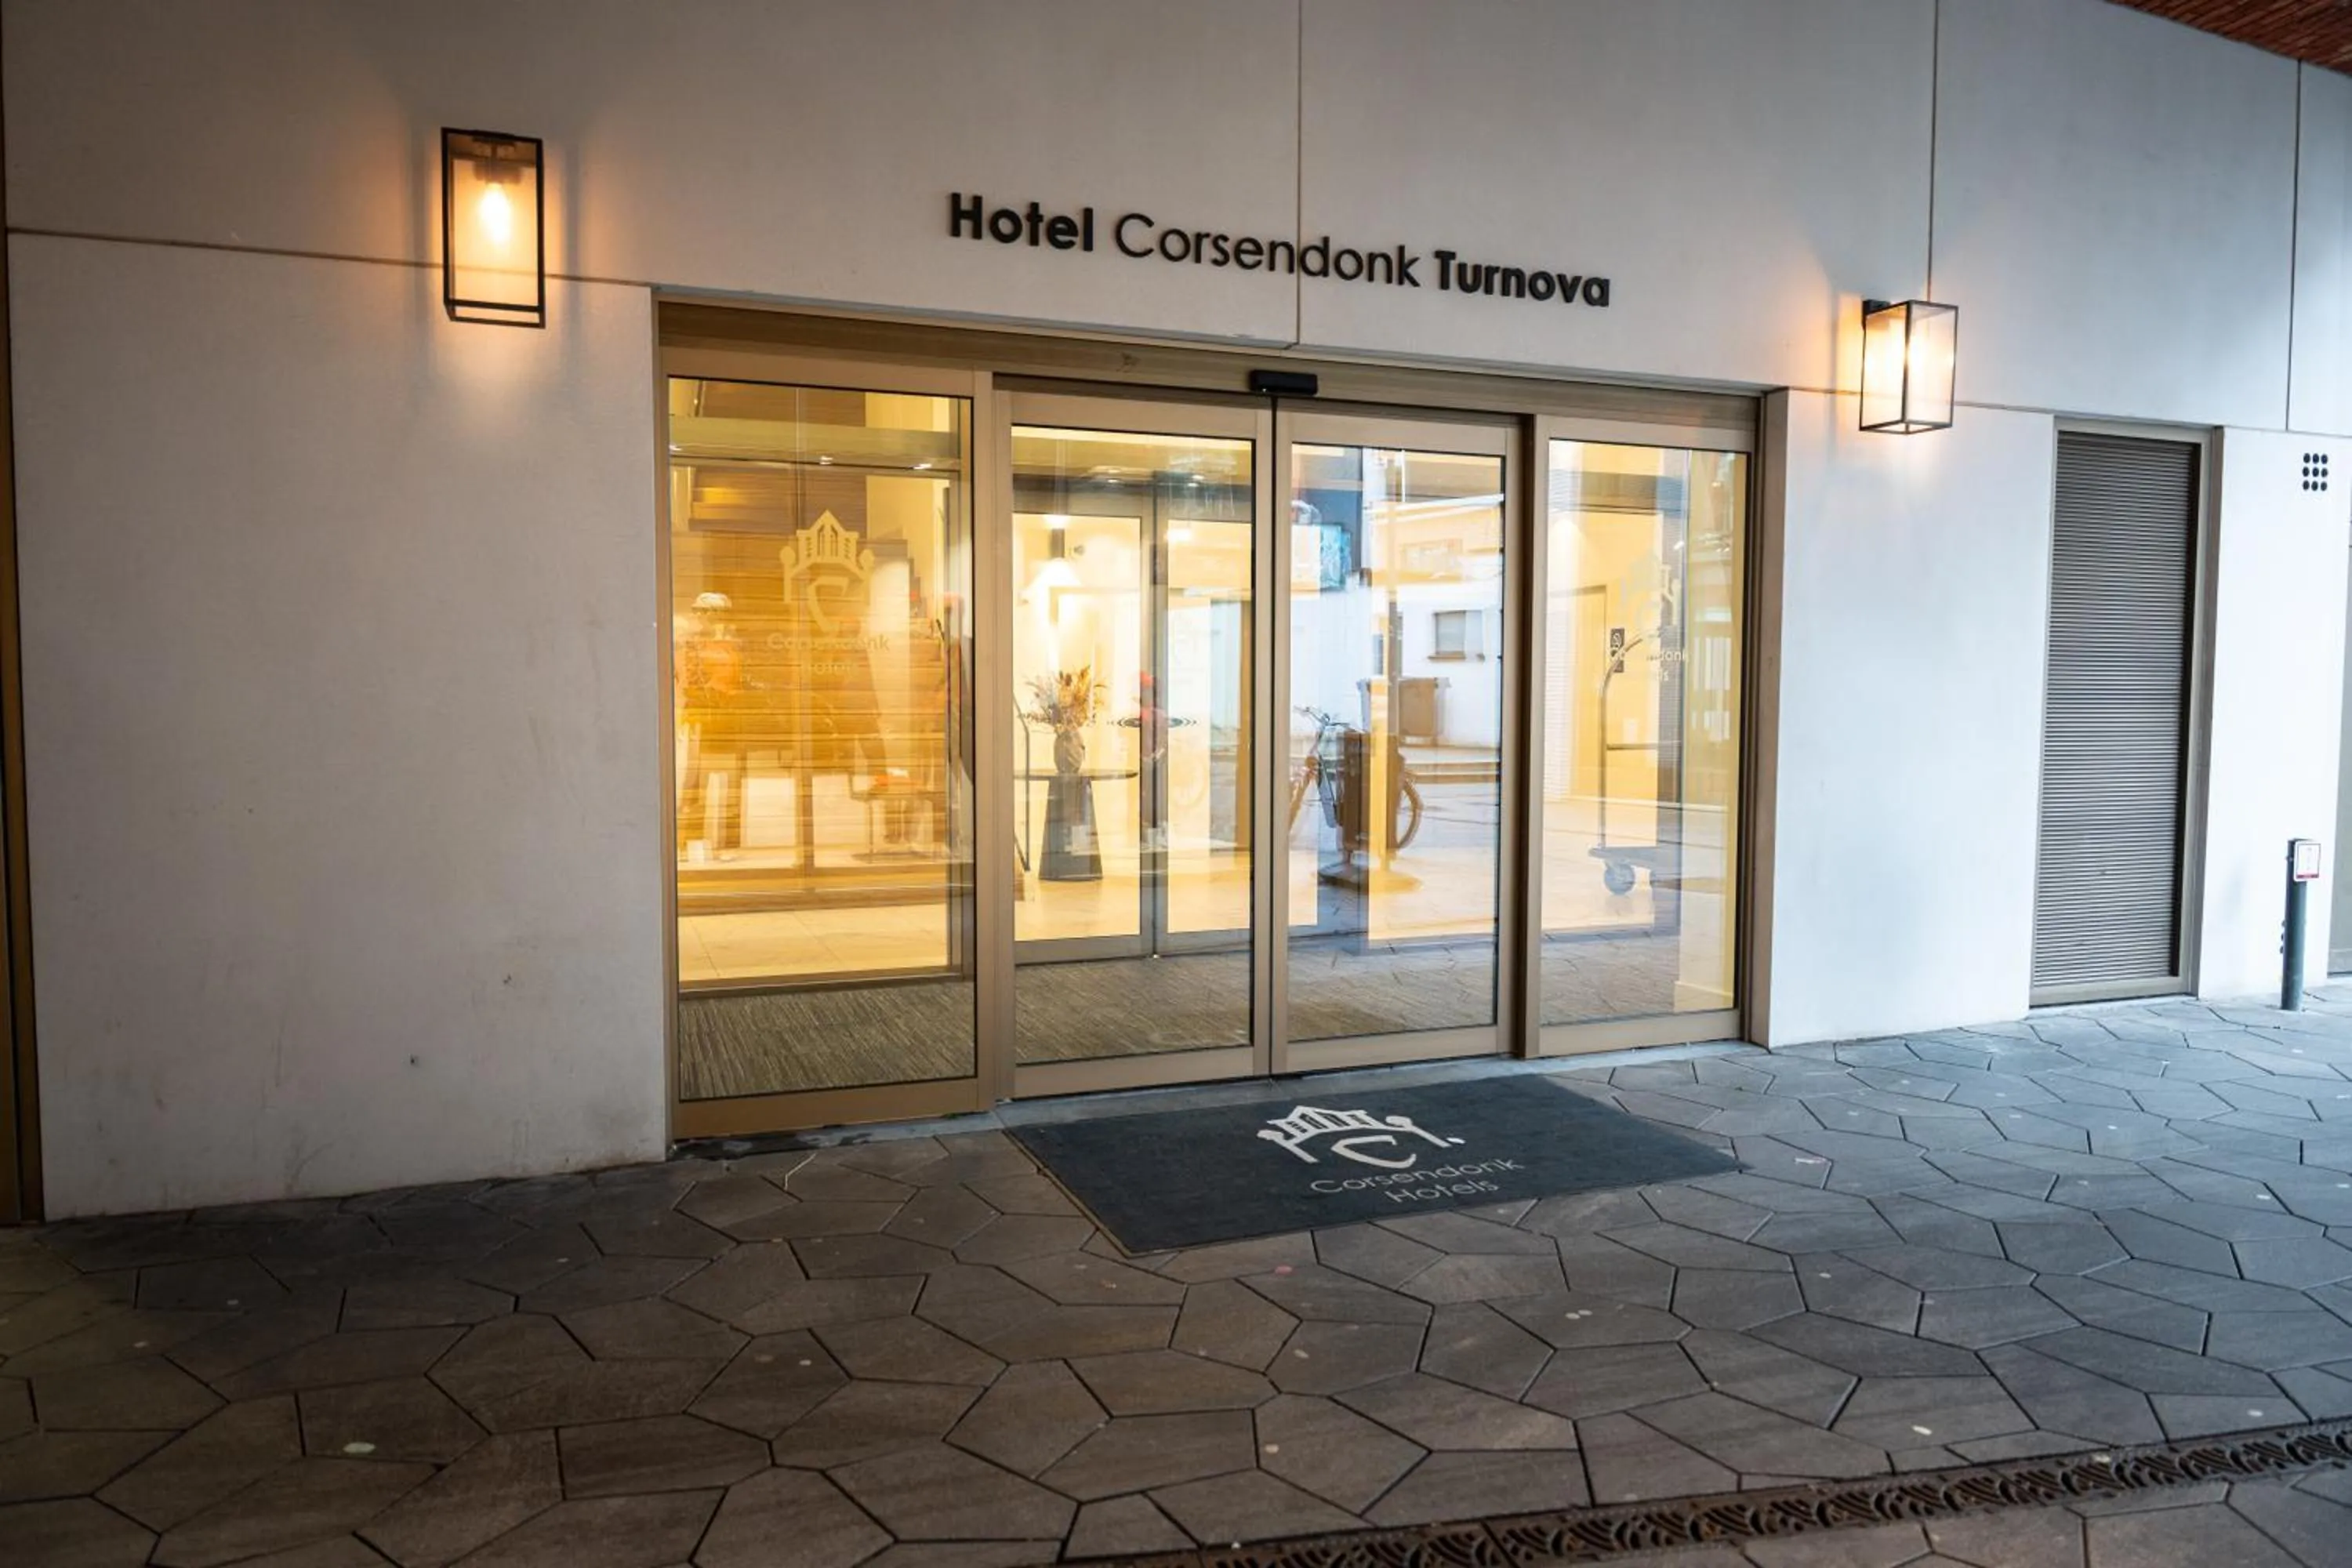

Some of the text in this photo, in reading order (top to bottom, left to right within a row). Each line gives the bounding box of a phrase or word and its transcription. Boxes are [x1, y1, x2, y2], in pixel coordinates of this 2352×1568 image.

[948, 192, 1610, 307] Hotel Corsendonk Turnova
[1310, 1157, 1526, 1194] Corsendonk
[1385, 1177, 1499, 1203] Hotels
